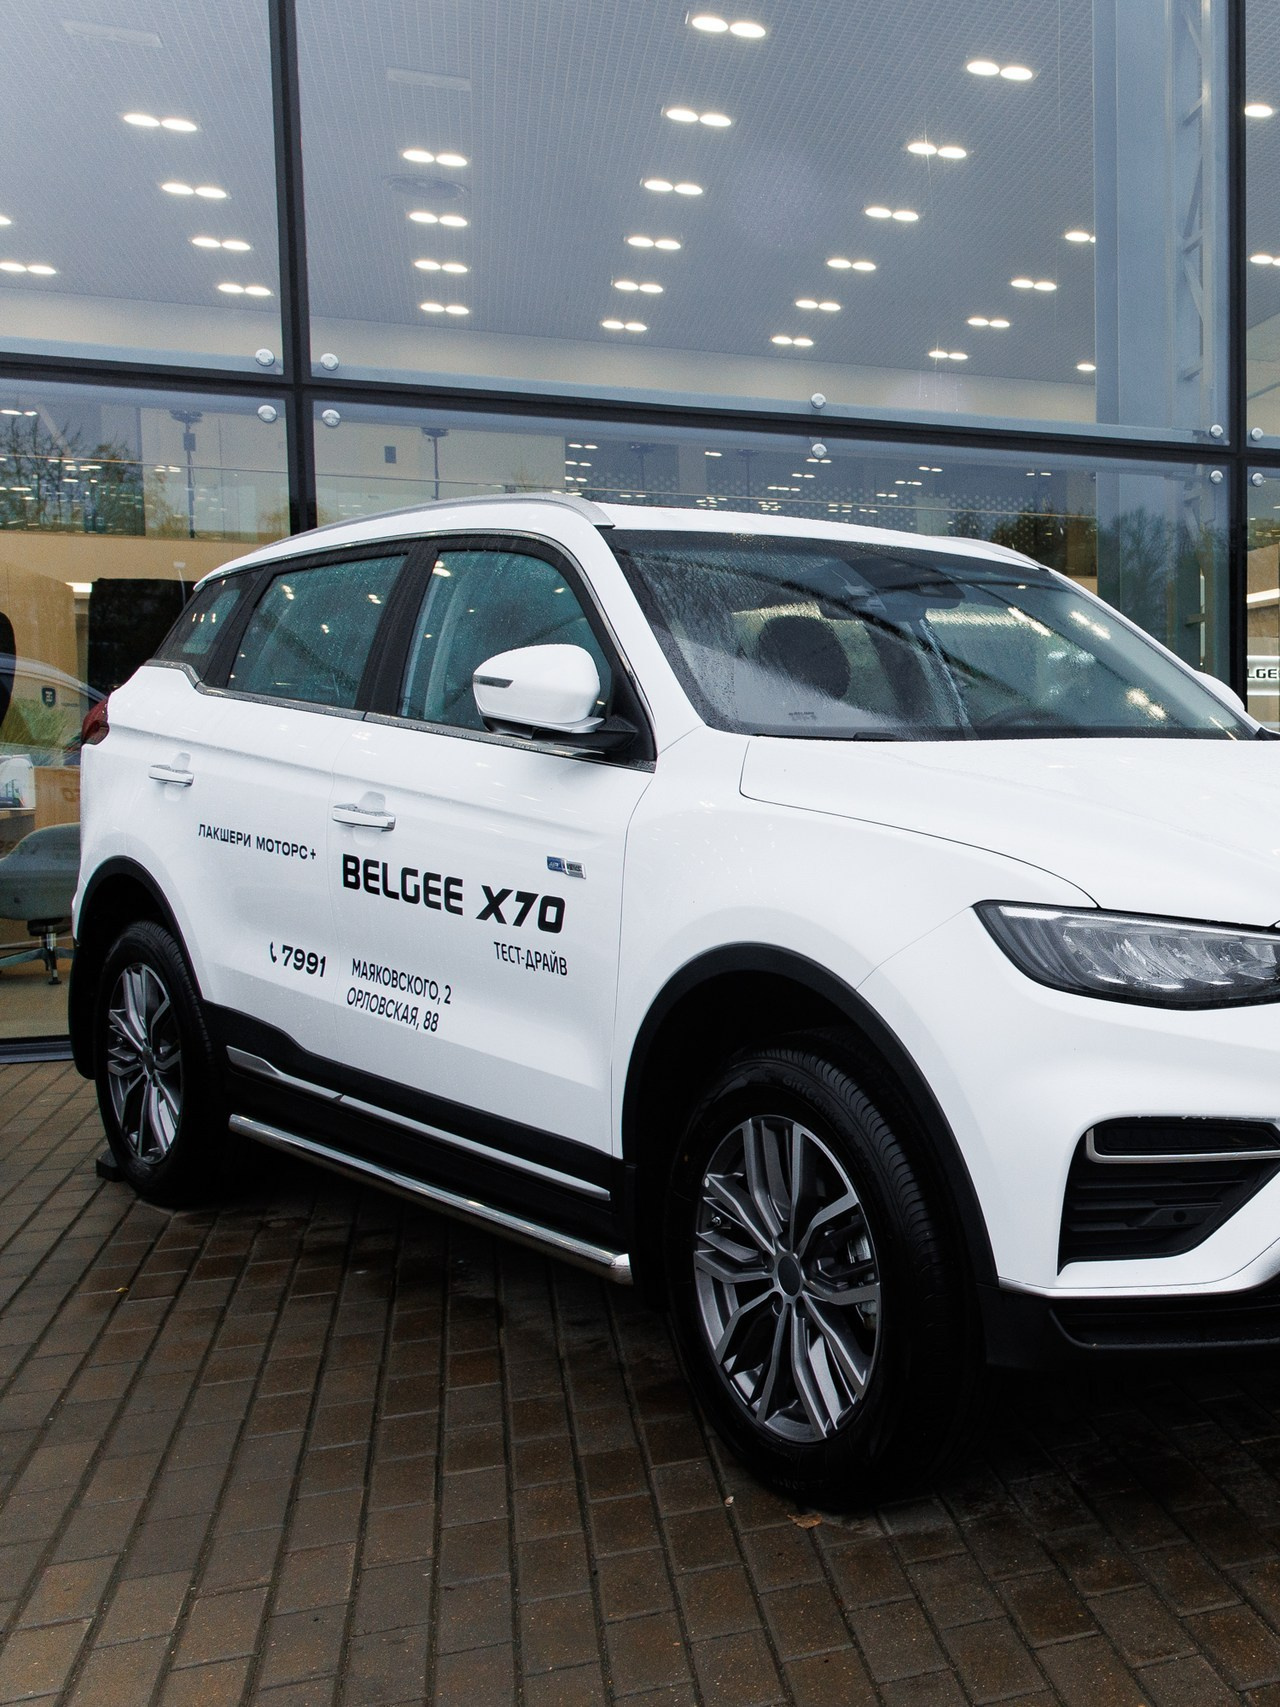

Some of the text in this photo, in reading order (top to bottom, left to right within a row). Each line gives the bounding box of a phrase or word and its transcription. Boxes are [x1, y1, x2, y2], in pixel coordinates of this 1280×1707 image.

[198, 823, 252, 848] ЛАКШЕРИ
[342, 853, 566, 934] BELGEE X70
[281, 943, 327, 978] 7991
[493, 941, 568, 977] ТЕСТ-ДРАЙВ
[351, 958, 452, 1005] МАЯКОВСКОГО, 2
[346, 987, 440, 1032] ОРЛОВСКАЯ, 88
